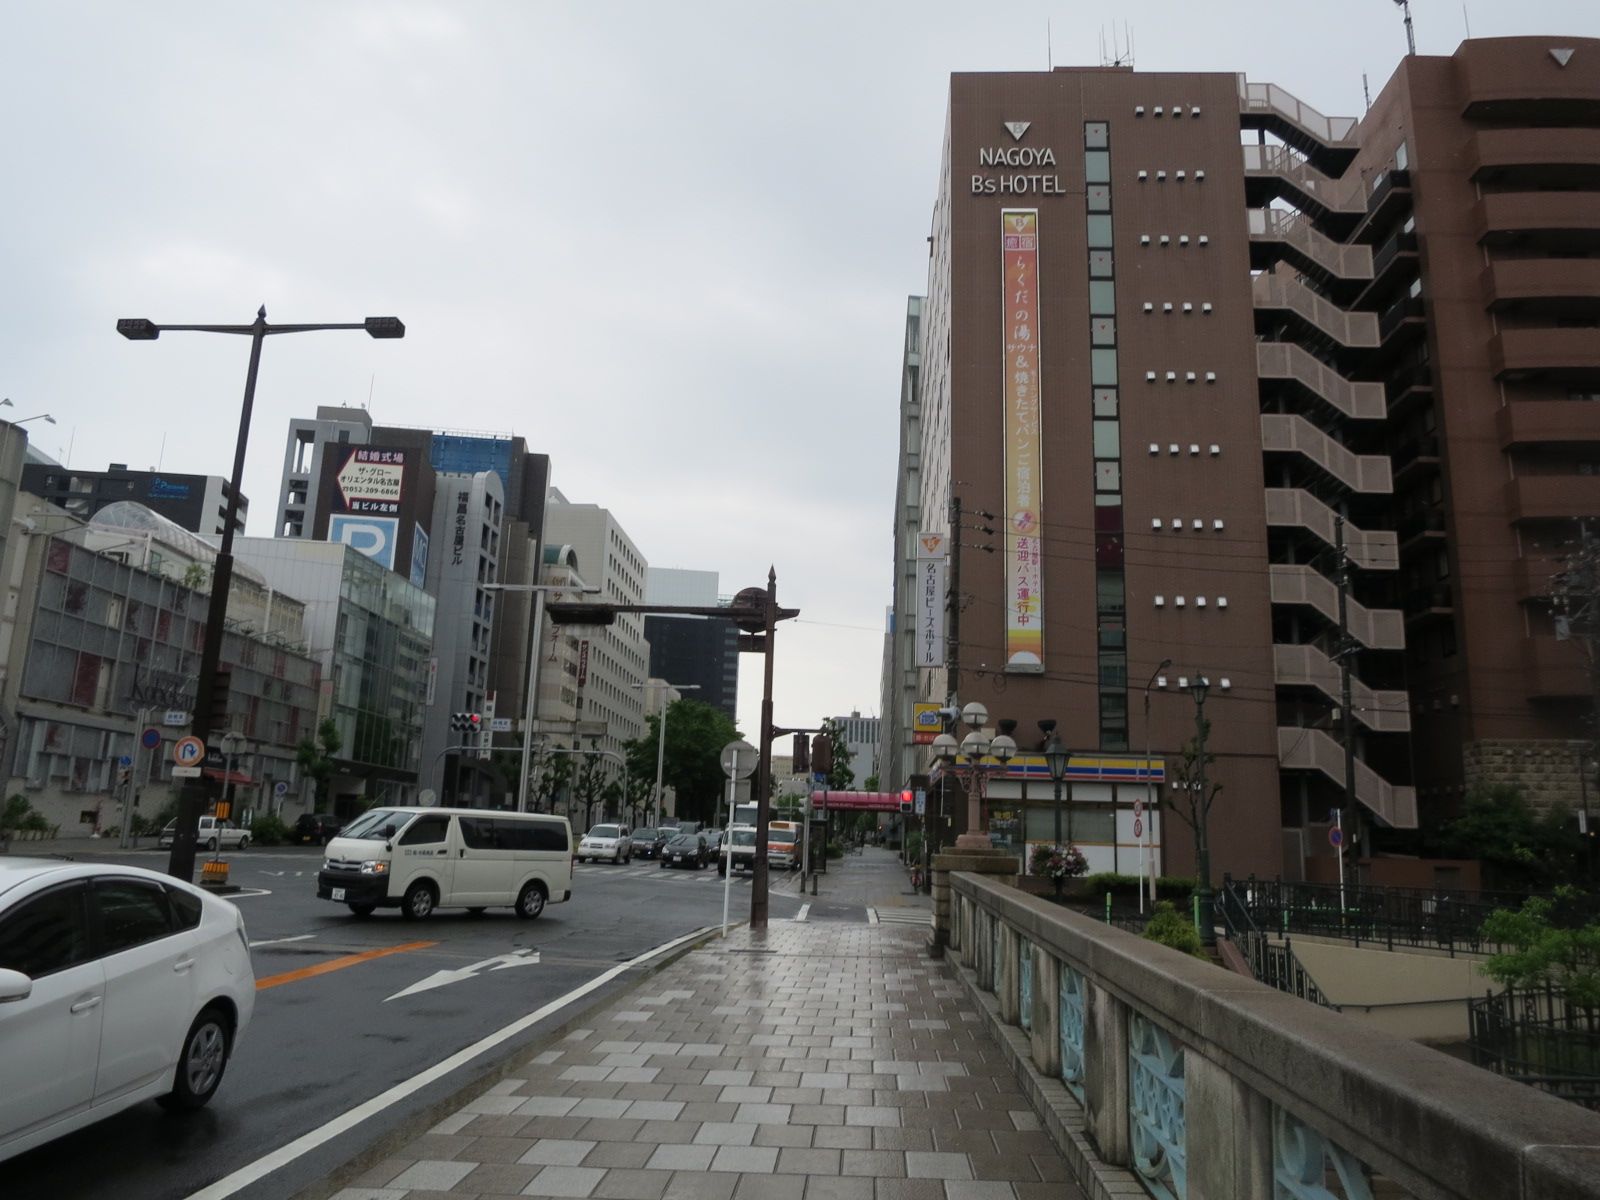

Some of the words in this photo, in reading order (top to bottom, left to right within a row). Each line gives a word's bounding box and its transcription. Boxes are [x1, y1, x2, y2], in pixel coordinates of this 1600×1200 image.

[979, 147, 1056, 166] NAGOYA
[971, 175, 996, 193] Bs
[1000, 174, 1066, 193] HOTEL
[357, 450, 404, 463] 結婚式場
[340, 475, 400, 487] オリエンタル名古屋
[351, 501, 398, 513] 当ビル左側
[341, 523, 385, 557] P
[1016, 537, 1030, 627] 送迎バス運行中
